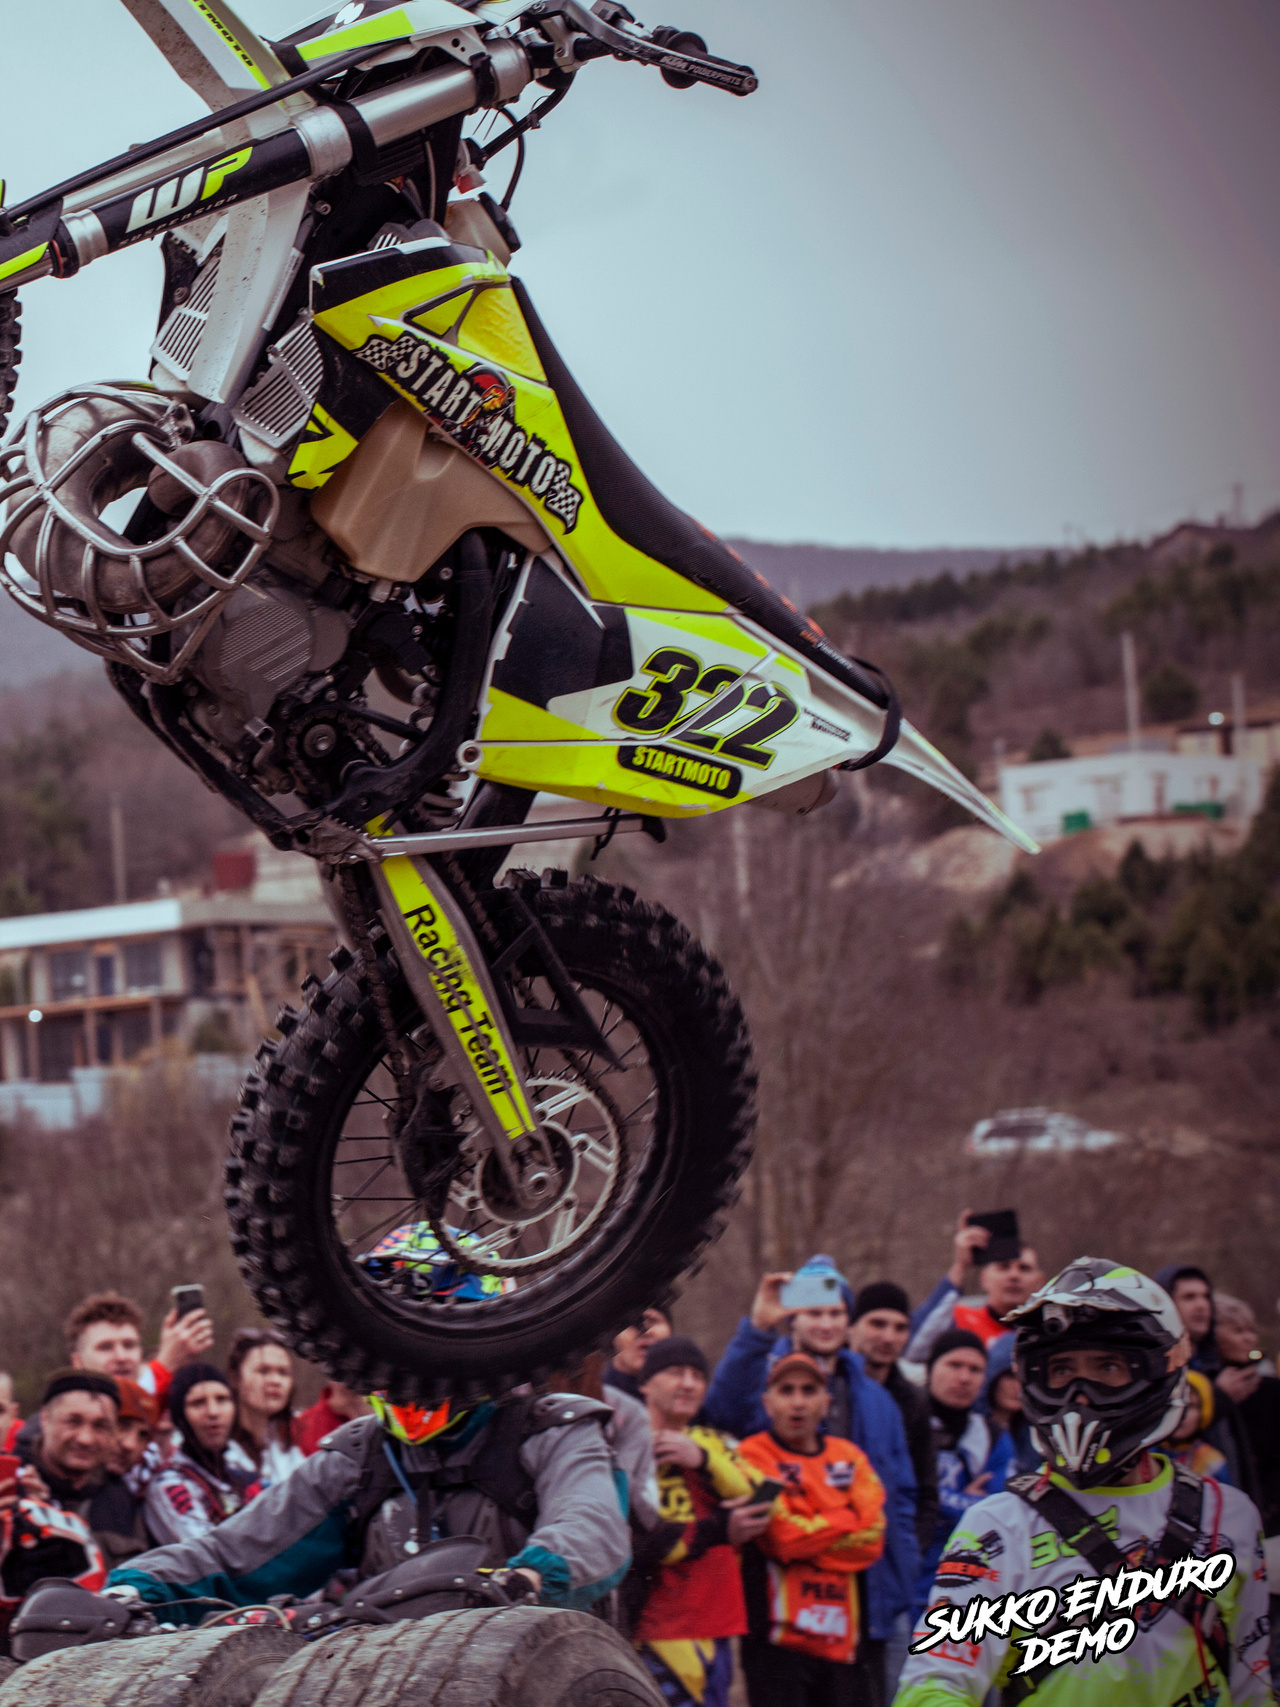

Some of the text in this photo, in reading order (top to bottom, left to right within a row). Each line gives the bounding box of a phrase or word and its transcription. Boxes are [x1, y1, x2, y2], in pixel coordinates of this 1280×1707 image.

[193, 0, 253, 67] TMOTO
[125, 146, 253, 234] WP
[396, 344, 557, 494] START MOTO
[607, 646, 802, 770] 322
[631, 745, 732, 790] STARTMOTO
[403, 903, 514, 1095] Racing Team
